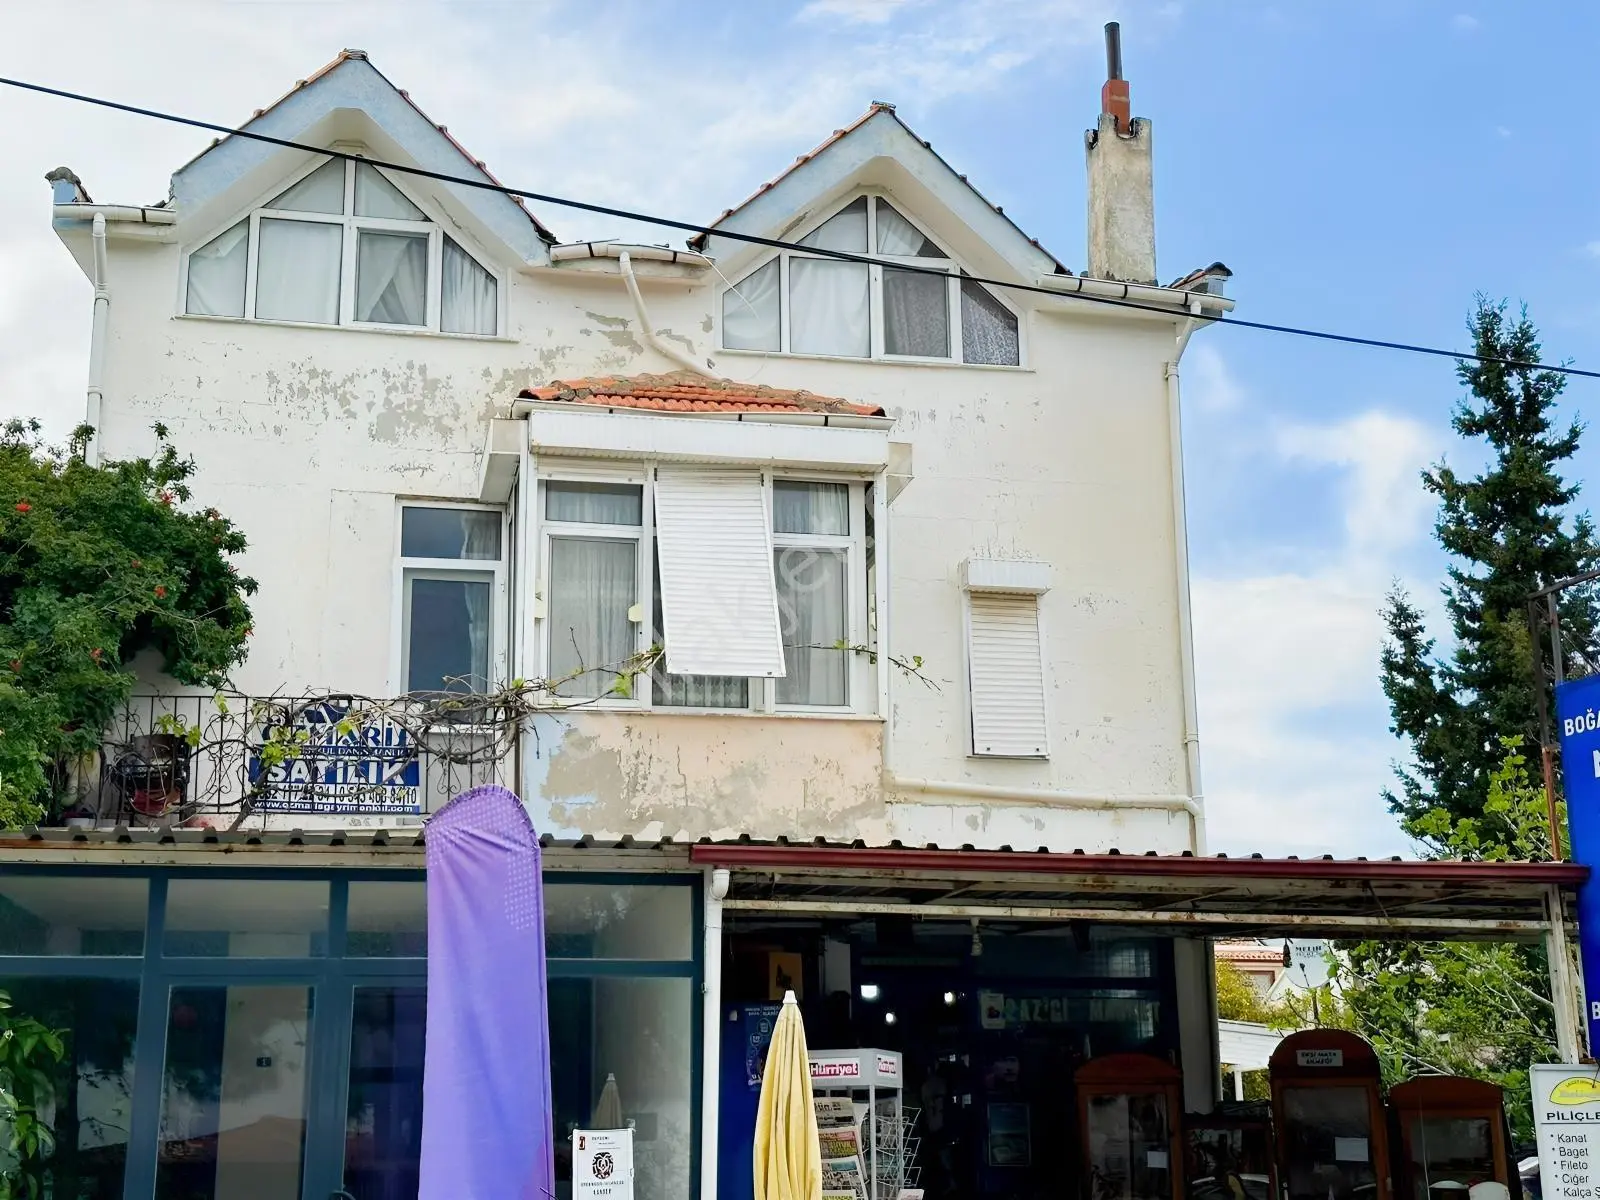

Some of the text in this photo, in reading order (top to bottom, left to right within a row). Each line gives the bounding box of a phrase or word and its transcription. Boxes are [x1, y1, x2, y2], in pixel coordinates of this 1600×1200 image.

[1564, 708, 1600, 736] BOĞ
[267, 759, 405, 784] SATILIK
[810, 1062, 858, 1077] Hürriyet
[1557, 1133, 1587, 1143] Kanat
[1559, 1147, 1589, 1158] Baget
[1560, 1160, 1588, 1170] Fileto
[1561, 1173, 1589, 1184] Ciğer
[1563, 1187, 1592, 1197] Kalça
